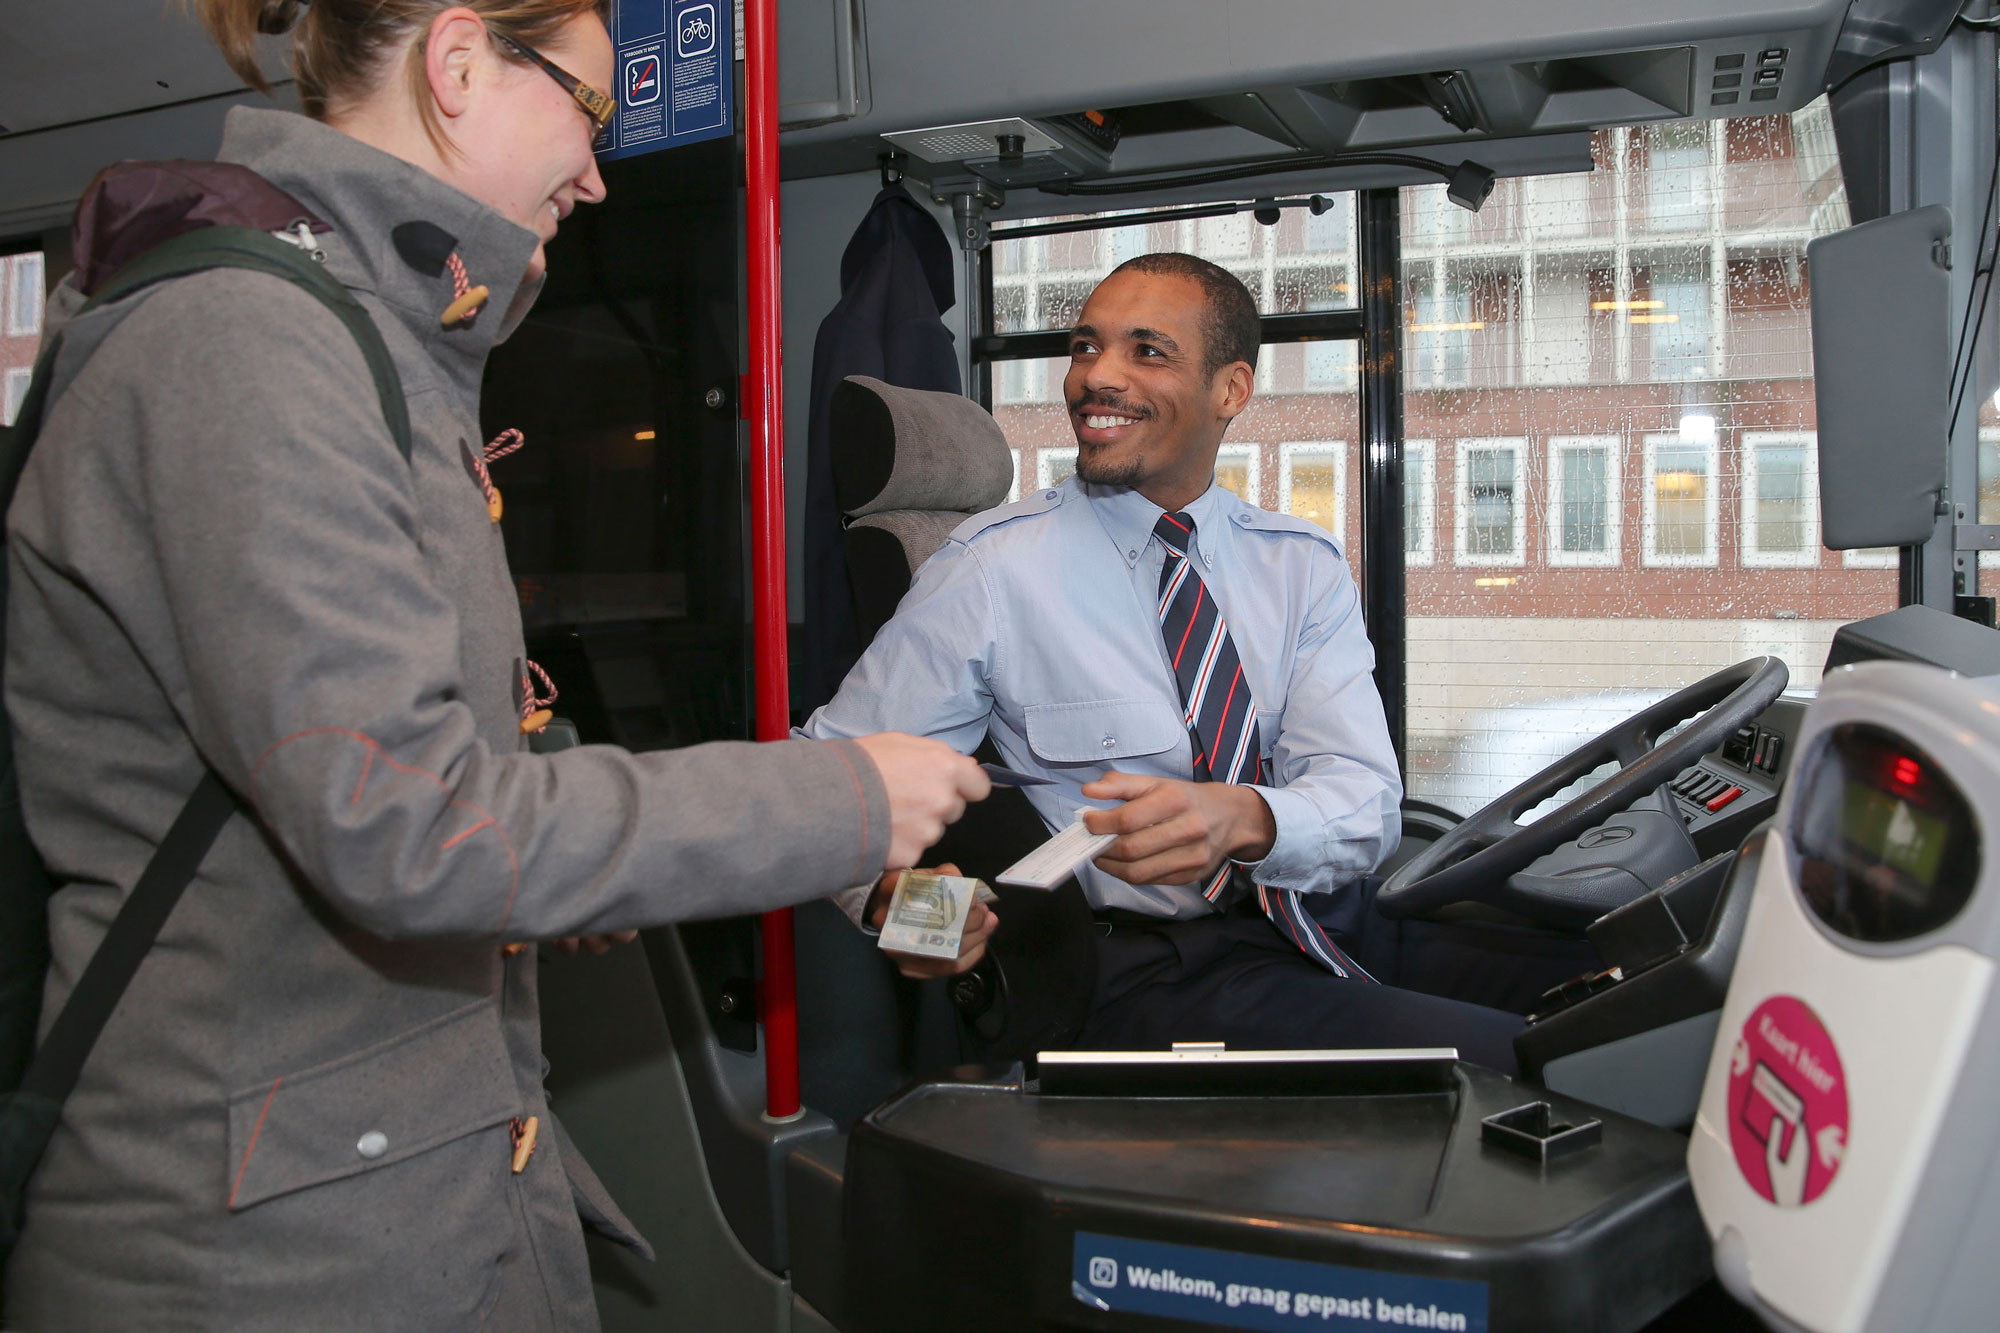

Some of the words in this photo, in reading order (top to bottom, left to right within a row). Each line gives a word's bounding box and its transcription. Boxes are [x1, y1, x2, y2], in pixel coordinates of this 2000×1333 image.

[1797, 1048, 1835, 1093] hier
[1127, 1265, 1223, 1303] Welkom,
[1225, 1283, 1291, 1314] graag
[1294, 1292, 1372, 1320] gepast
[1376, 1297, 1467, 1333] betalen
